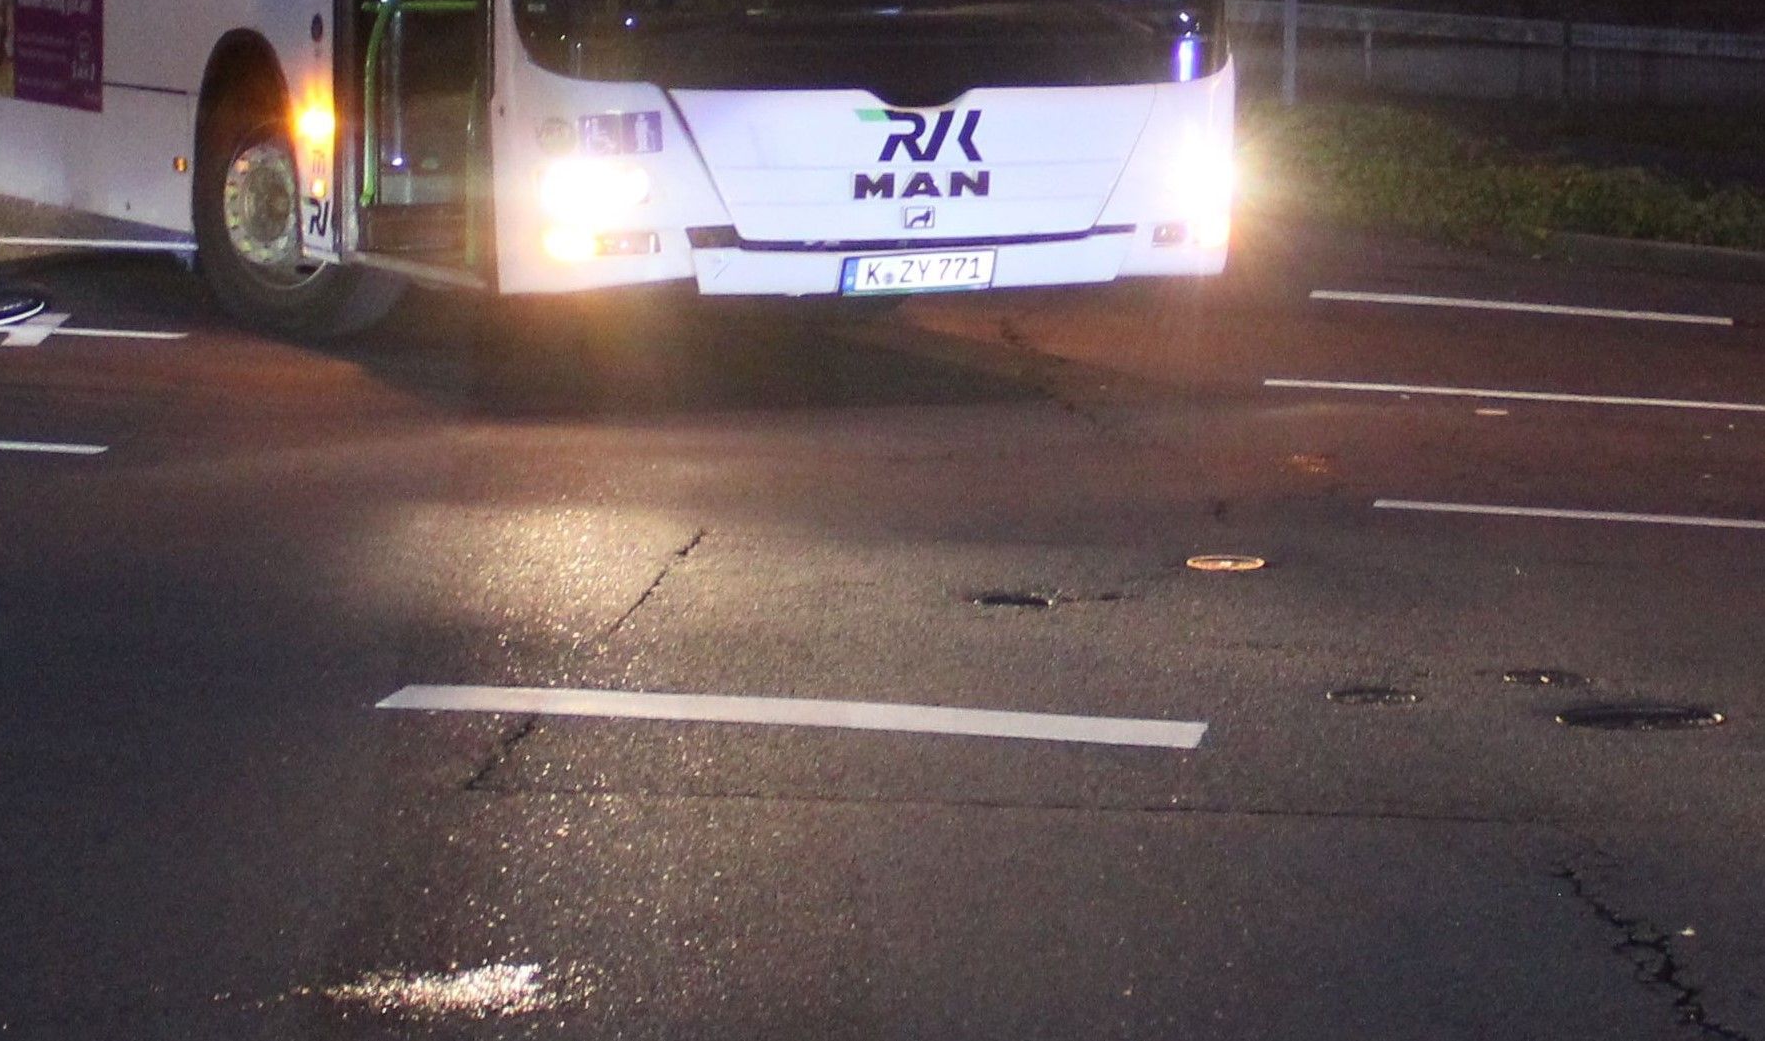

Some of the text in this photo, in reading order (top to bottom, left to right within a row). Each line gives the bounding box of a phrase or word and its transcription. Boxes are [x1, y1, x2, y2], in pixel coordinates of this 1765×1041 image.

[852, 170, 990, 200] MAN
[865, 256, 981, 286] K ZY 771
